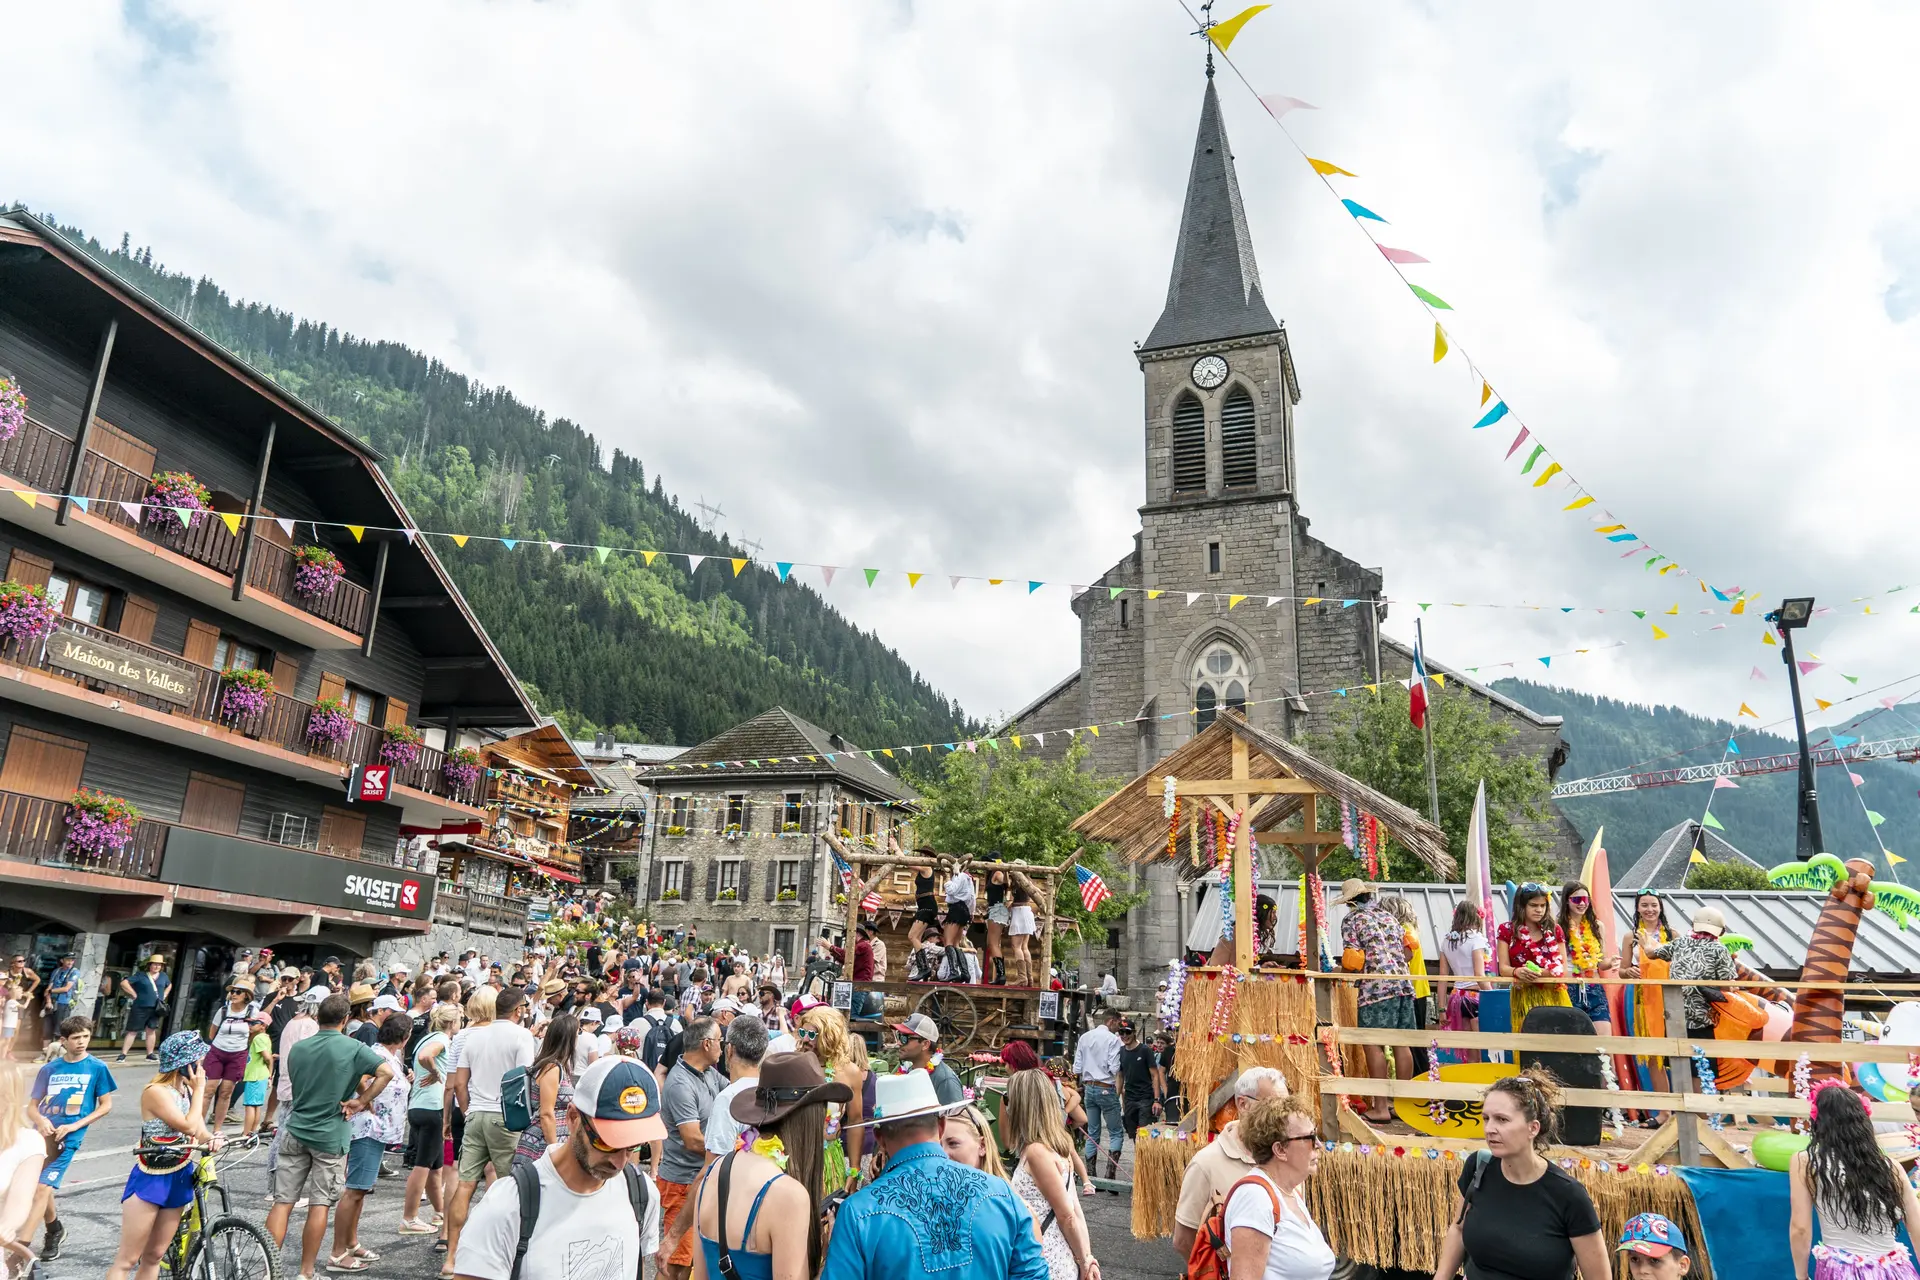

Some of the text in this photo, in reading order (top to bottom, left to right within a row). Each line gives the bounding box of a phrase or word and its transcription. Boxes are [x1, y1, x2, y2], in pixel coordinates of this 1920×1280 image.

[62, 641, 185, 694] Maison des Vallets
[344, 874, 402, 902] SKISET
